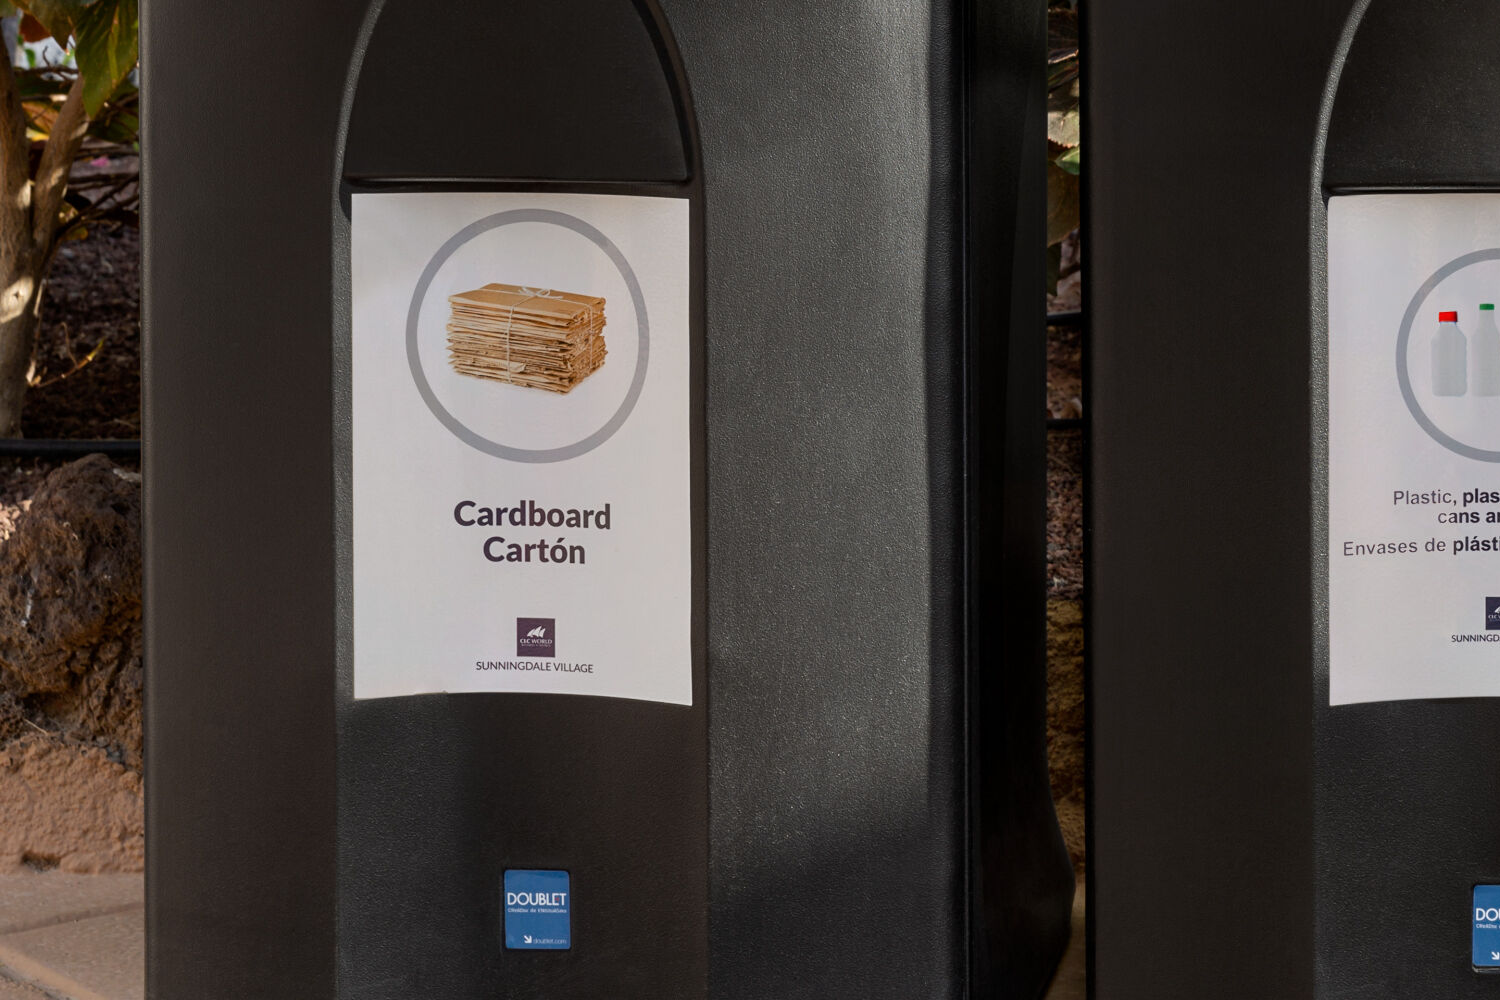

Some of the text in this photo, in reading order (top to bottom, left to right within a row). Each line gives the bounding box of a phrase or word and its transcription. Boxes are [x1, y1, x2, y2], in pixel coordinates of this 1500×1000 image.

[1393, 489, 1457, 507] Plastic,
[454, 500, 611, 530] Cardboard
[1438, 512, 1480, 523] cans
[483, 536, 585, 564] Cartón
[1343, 539, 1419, 557] Envases
[1425, 538, 1446, 552] de
[476, 661, 593, 673] SUNNINGDALE VILLAGE
[508, 892, 566, 905] DOUBLET
